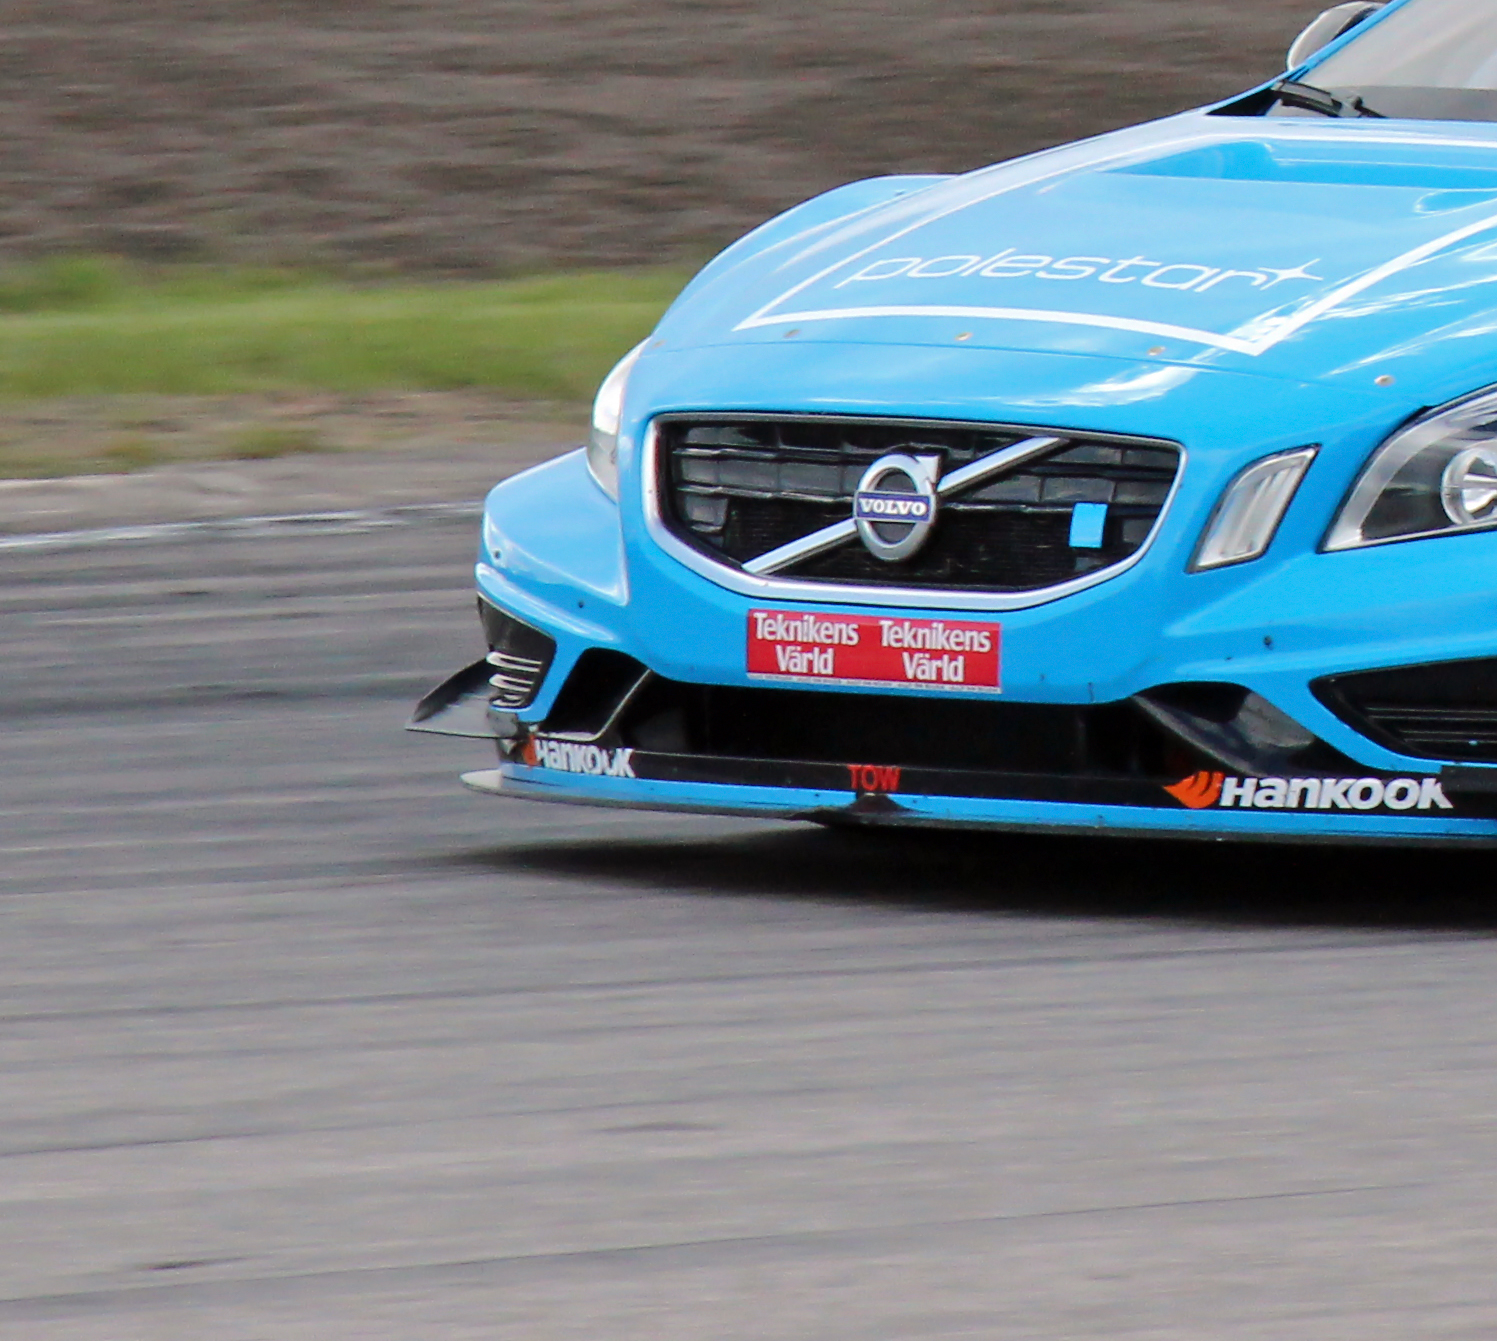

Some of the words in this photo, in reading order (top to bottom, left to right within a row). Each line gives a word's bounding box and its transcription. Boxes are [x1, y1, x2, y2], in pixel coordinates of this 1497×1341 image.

[834, 248, 1272, 292] polestar
[859, 498, 928, 516] VOLVO
[753, 612, 859, 646] Teknikens
[879, 620, 991, 653] Teknikens
[775, 644, 834, 675] Värld
[902, 651, 965, 682] Värld
[848, 764, 900, 791] TOW
